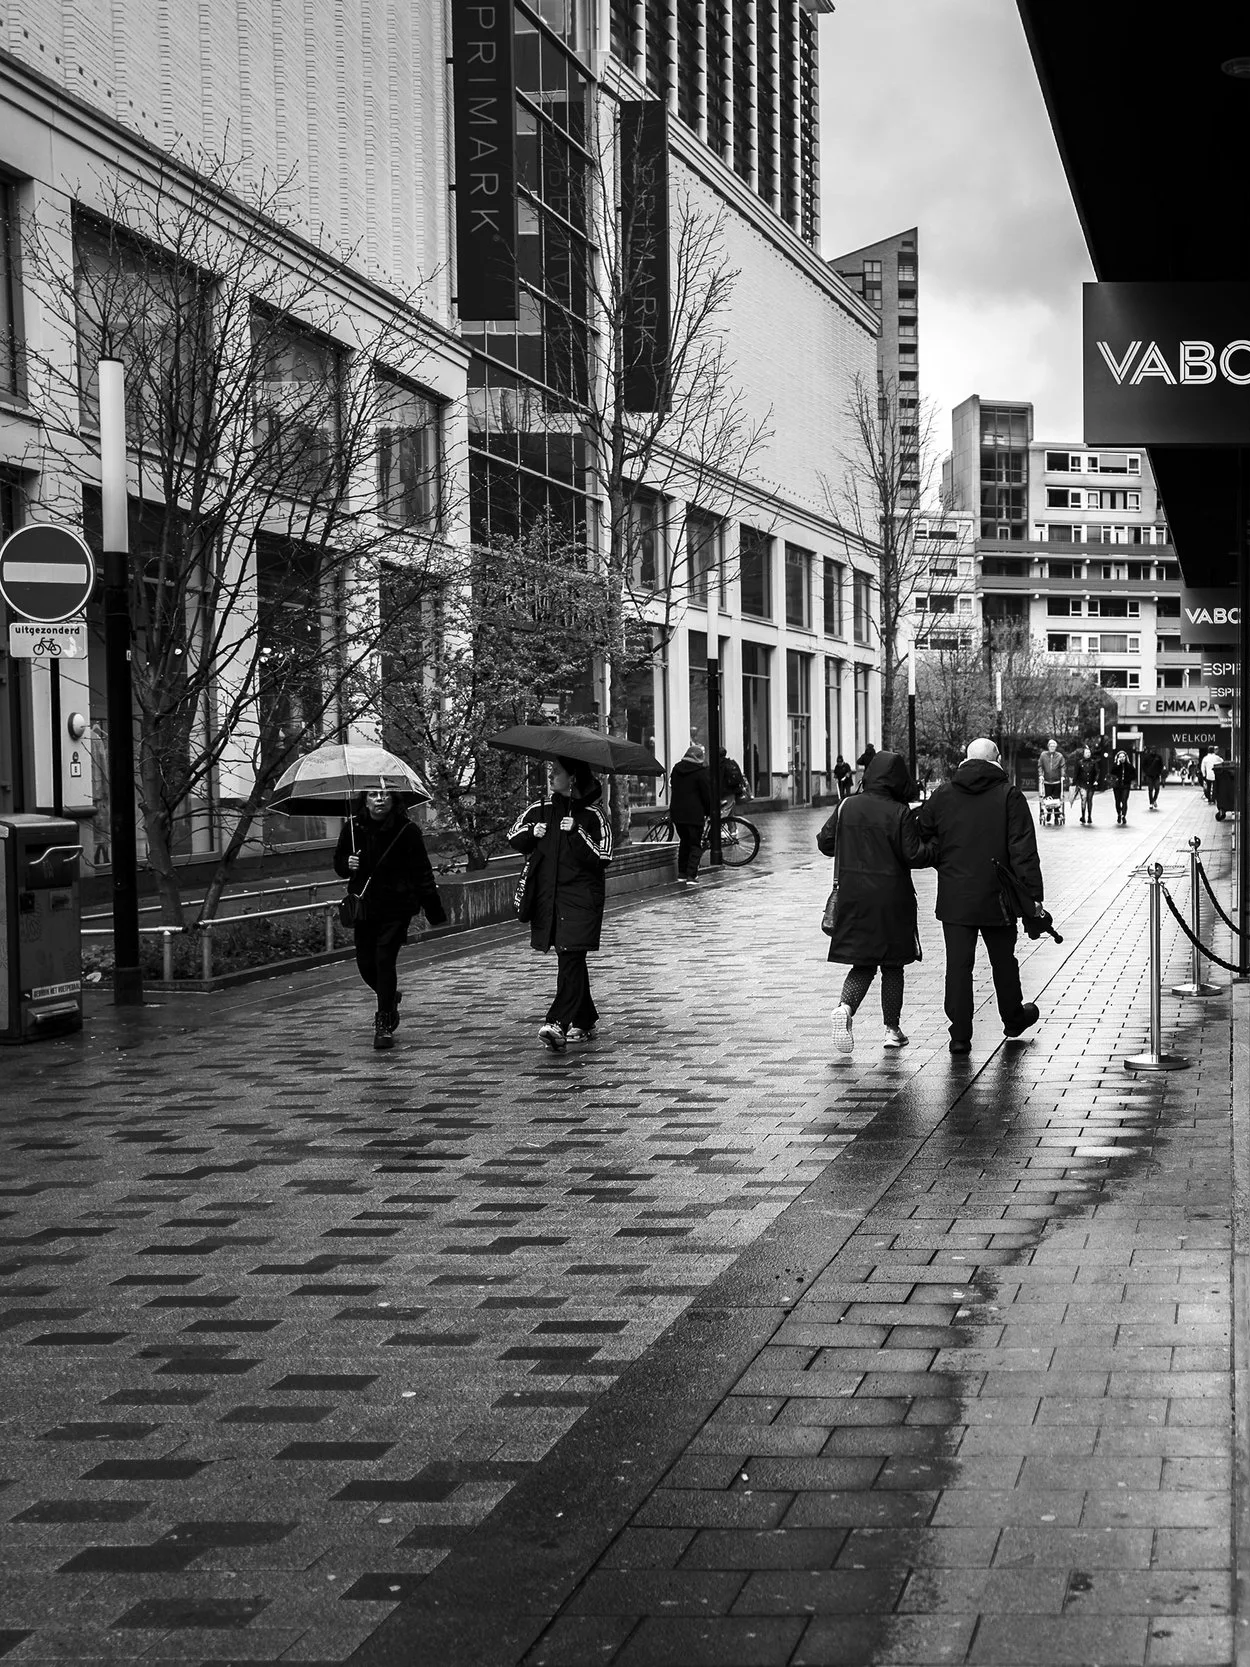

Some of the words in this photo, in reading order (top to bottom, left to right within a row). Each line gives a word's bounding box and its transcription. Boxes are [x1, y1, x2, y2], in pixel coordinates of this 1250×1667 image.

[465, 6, 500, 234] PRIMARK
[632, 166, 658, 346] PRIMARK
[15, 626, 80, 636] uitgezonderd
[1156, 700, 1196, 712] EMMA
[1171, 733, 1216, 743] WELKOM
